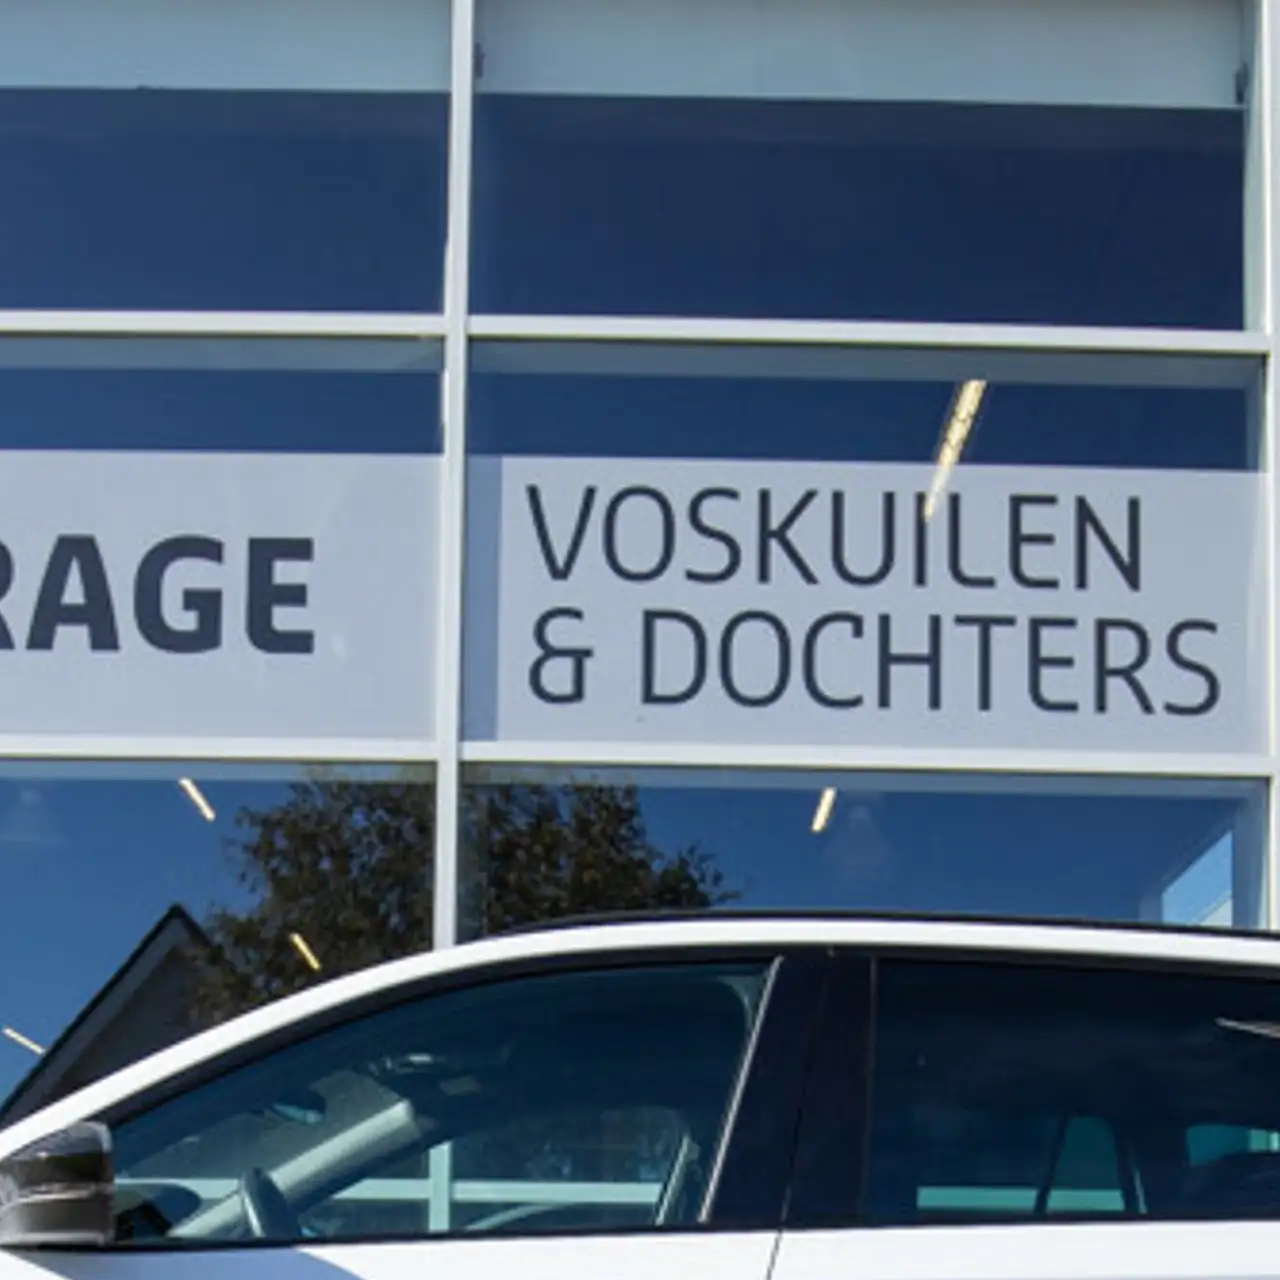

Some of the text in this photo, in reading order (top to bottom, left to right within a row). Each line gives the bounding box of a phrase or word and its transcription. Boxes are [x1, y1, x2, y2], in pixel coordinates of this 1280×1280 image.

[525, 484, 1143, 592] VOSKUILEN
[528, 607, 1222, 716] & DOCHTERS
